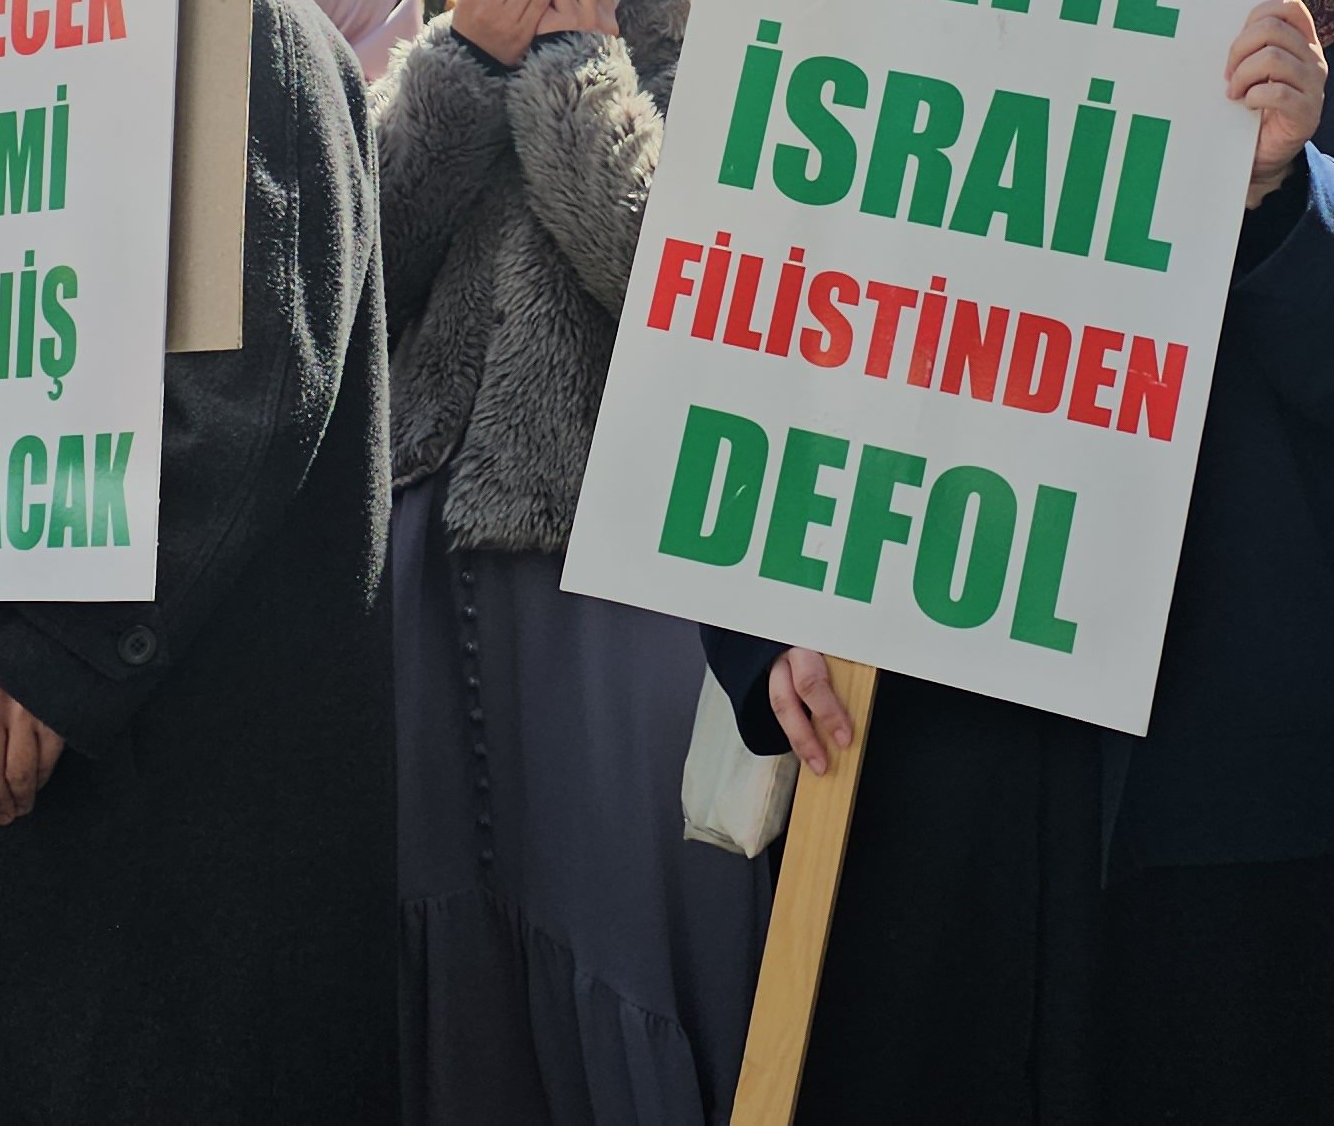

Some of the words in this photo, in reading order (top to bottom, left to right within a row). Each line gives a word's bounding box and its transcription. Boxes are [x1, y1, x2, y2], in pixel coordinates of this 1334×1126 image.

[718, 19, 1172, 272] İSRAİL
[647, 231, 1188, 442] FİLİSTİNDEN
[658, 404, 1078, 654] DEFOL
